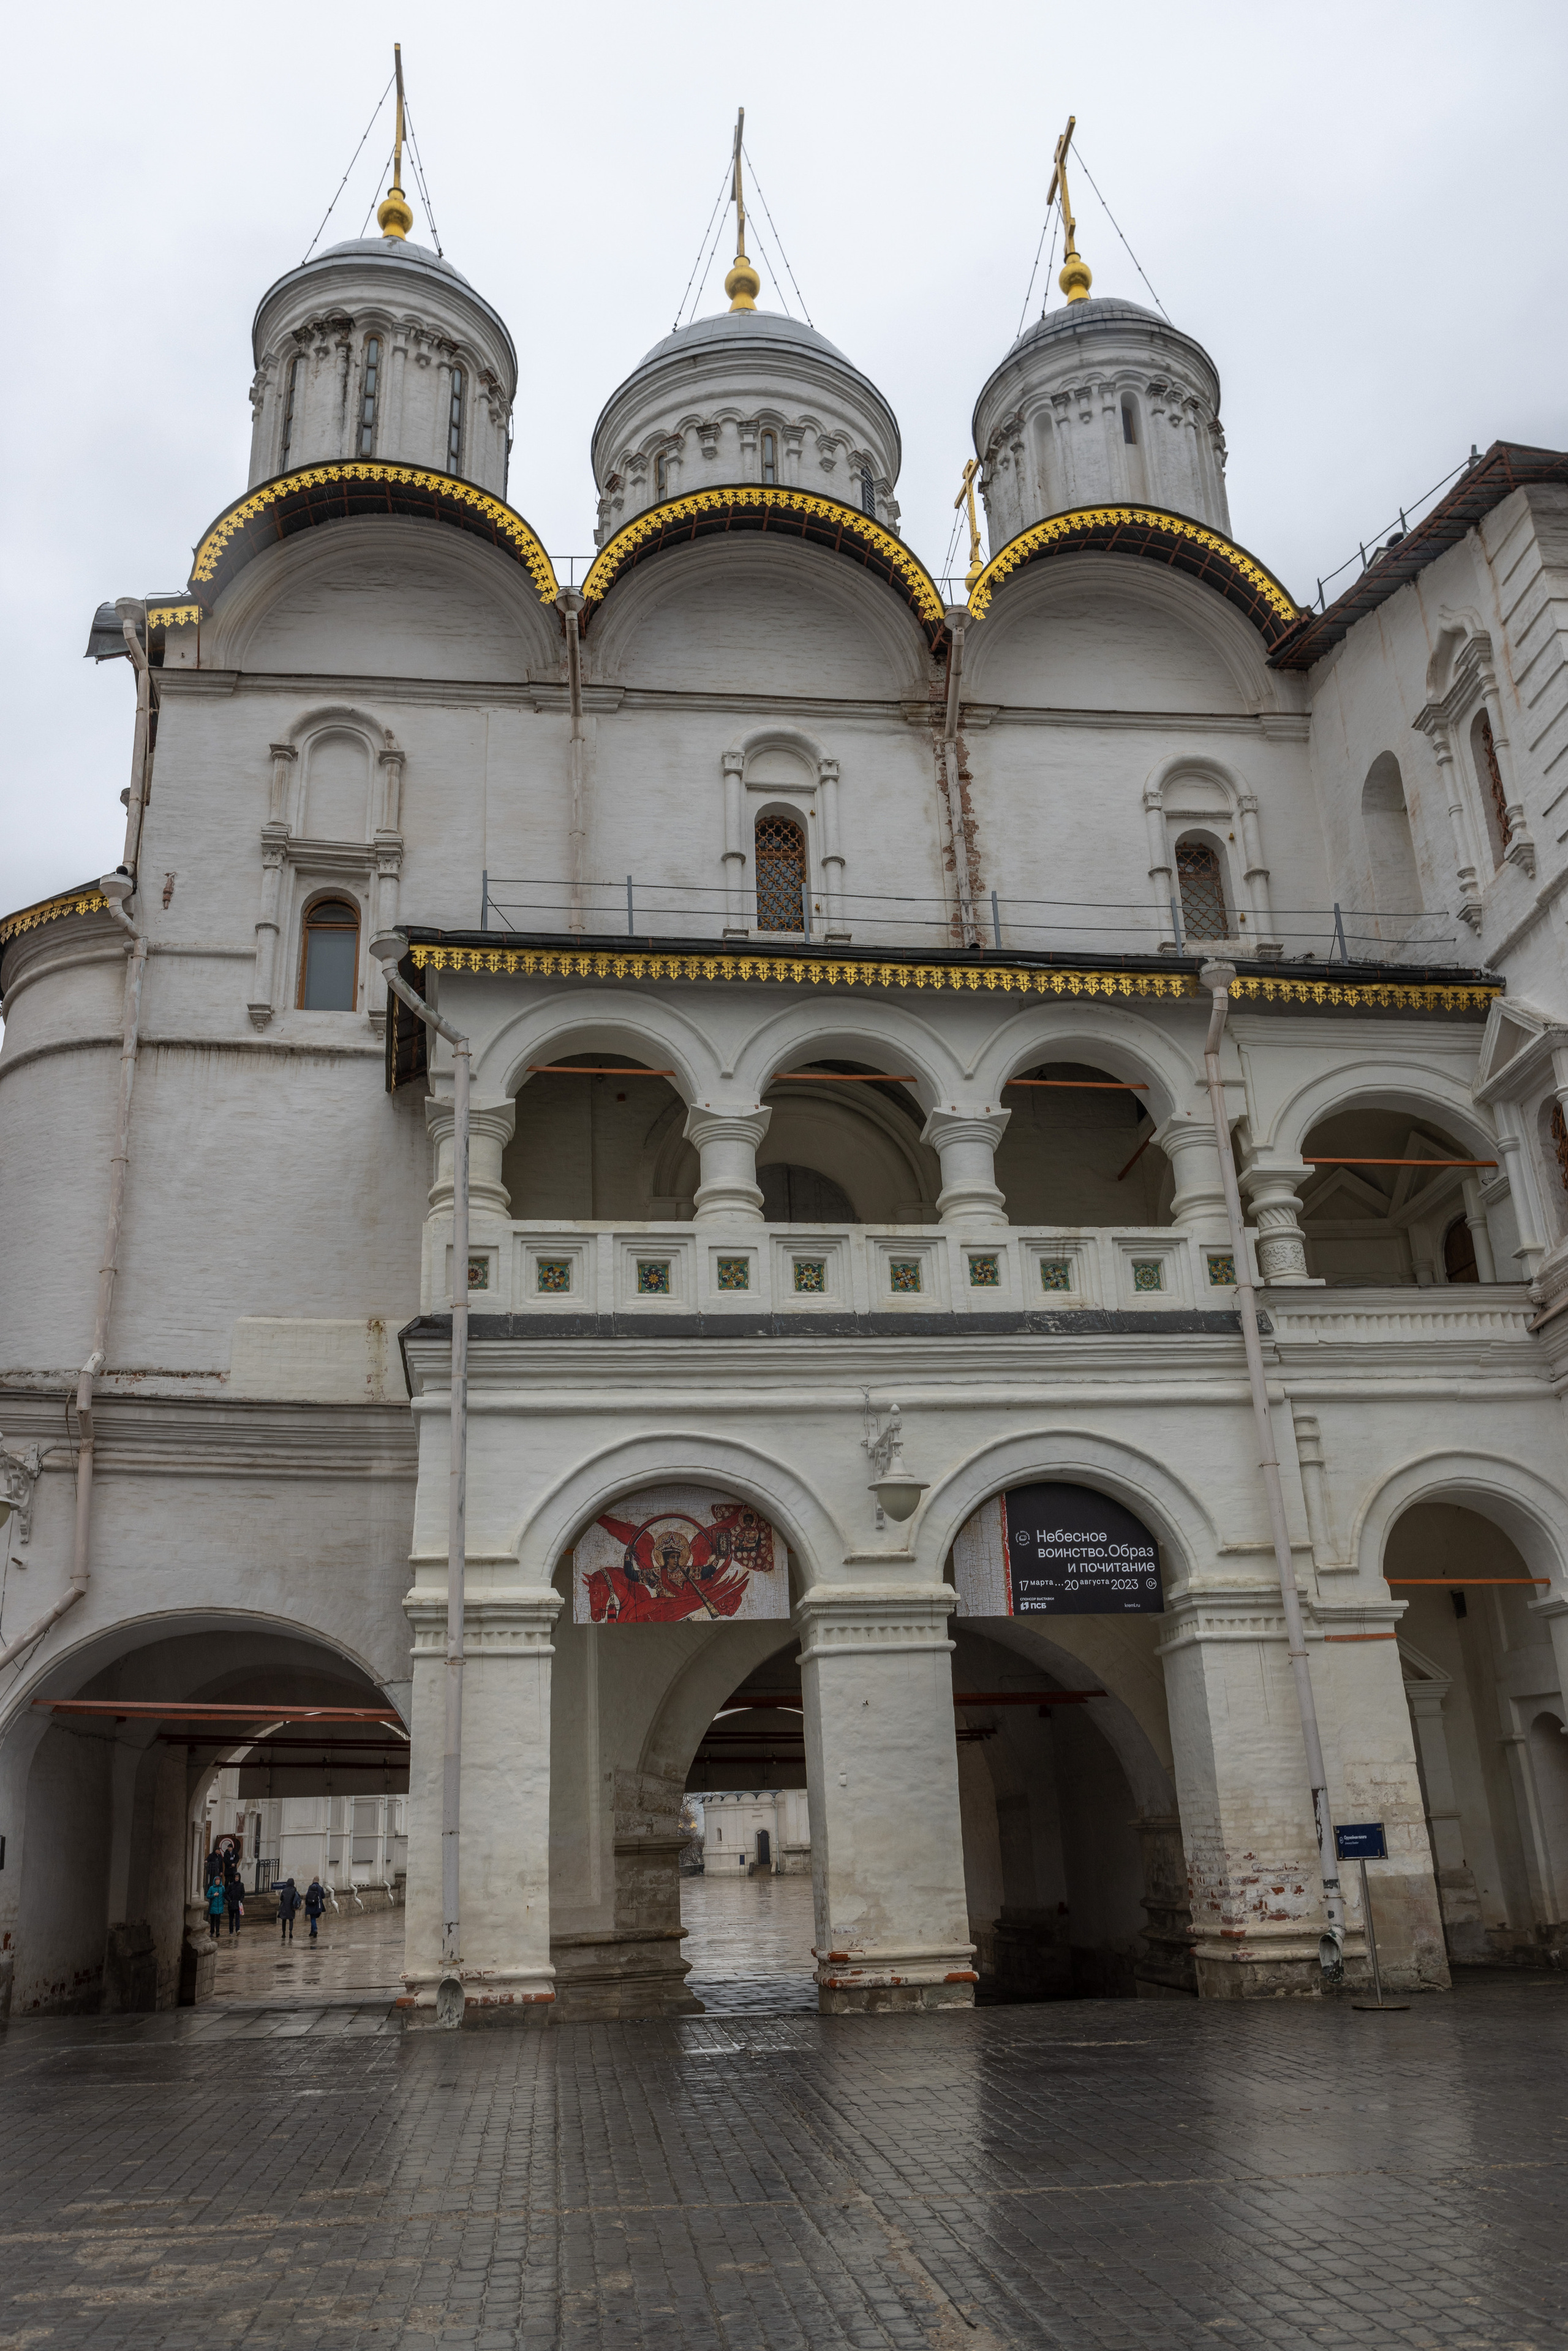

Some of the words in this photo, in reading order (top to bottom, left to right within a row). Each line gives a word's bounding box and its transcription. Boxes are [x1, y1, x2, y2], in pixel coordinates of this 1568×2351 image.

[1036, 1529, 1107, 1542] Небесное
[1068, 1563, 1076, 1572] и
[1080, 1562, 1155, 1572] почитание
[1019, 1580, 1029, 1591] 17
[1065, 1580, 1079, 1590] 20
[1111, 1579, 1139, 1590] 2023
